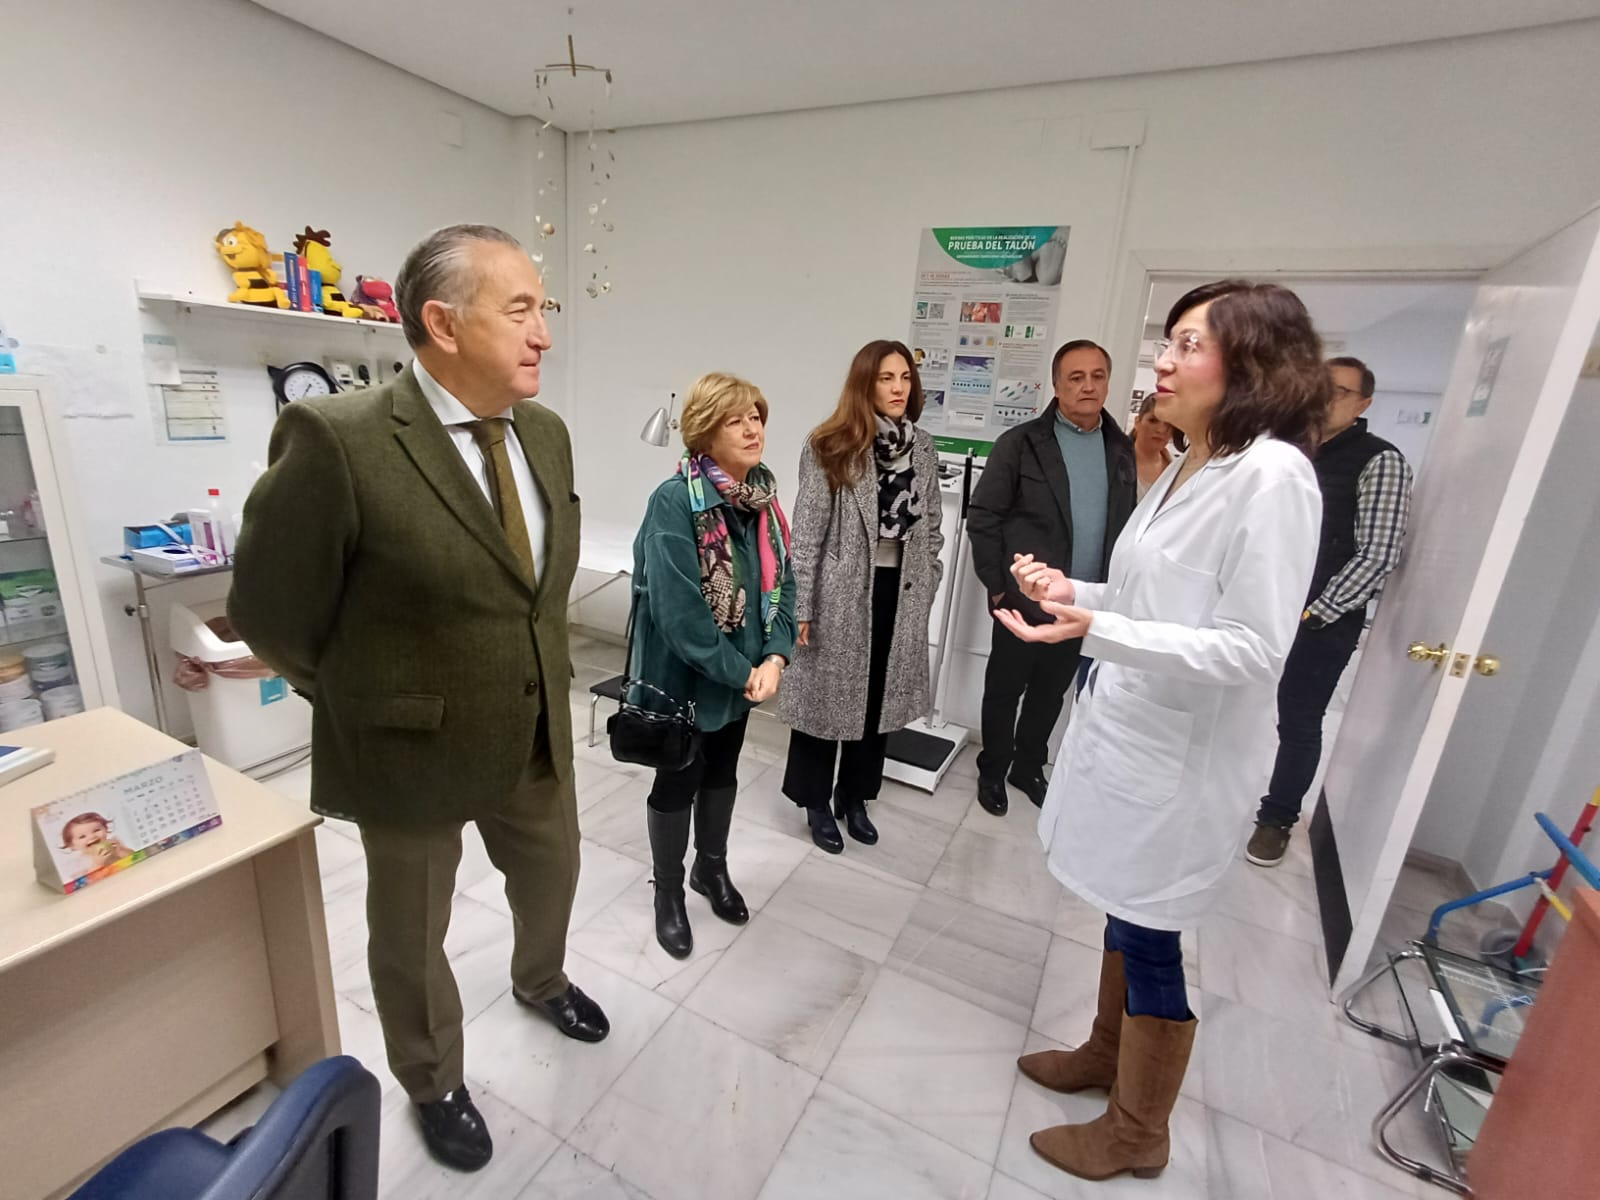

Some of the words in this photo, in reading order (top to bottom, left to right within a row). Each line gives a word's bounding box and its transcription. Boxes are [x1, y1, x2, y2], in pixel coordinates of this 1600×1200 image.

[948, 241, 983, 250] PRUEBA
[985, 241, 1003, 250] DEL
[1005, 238, 1036, 250] TALÓN
[124, 776, 162, 794] MARZO
